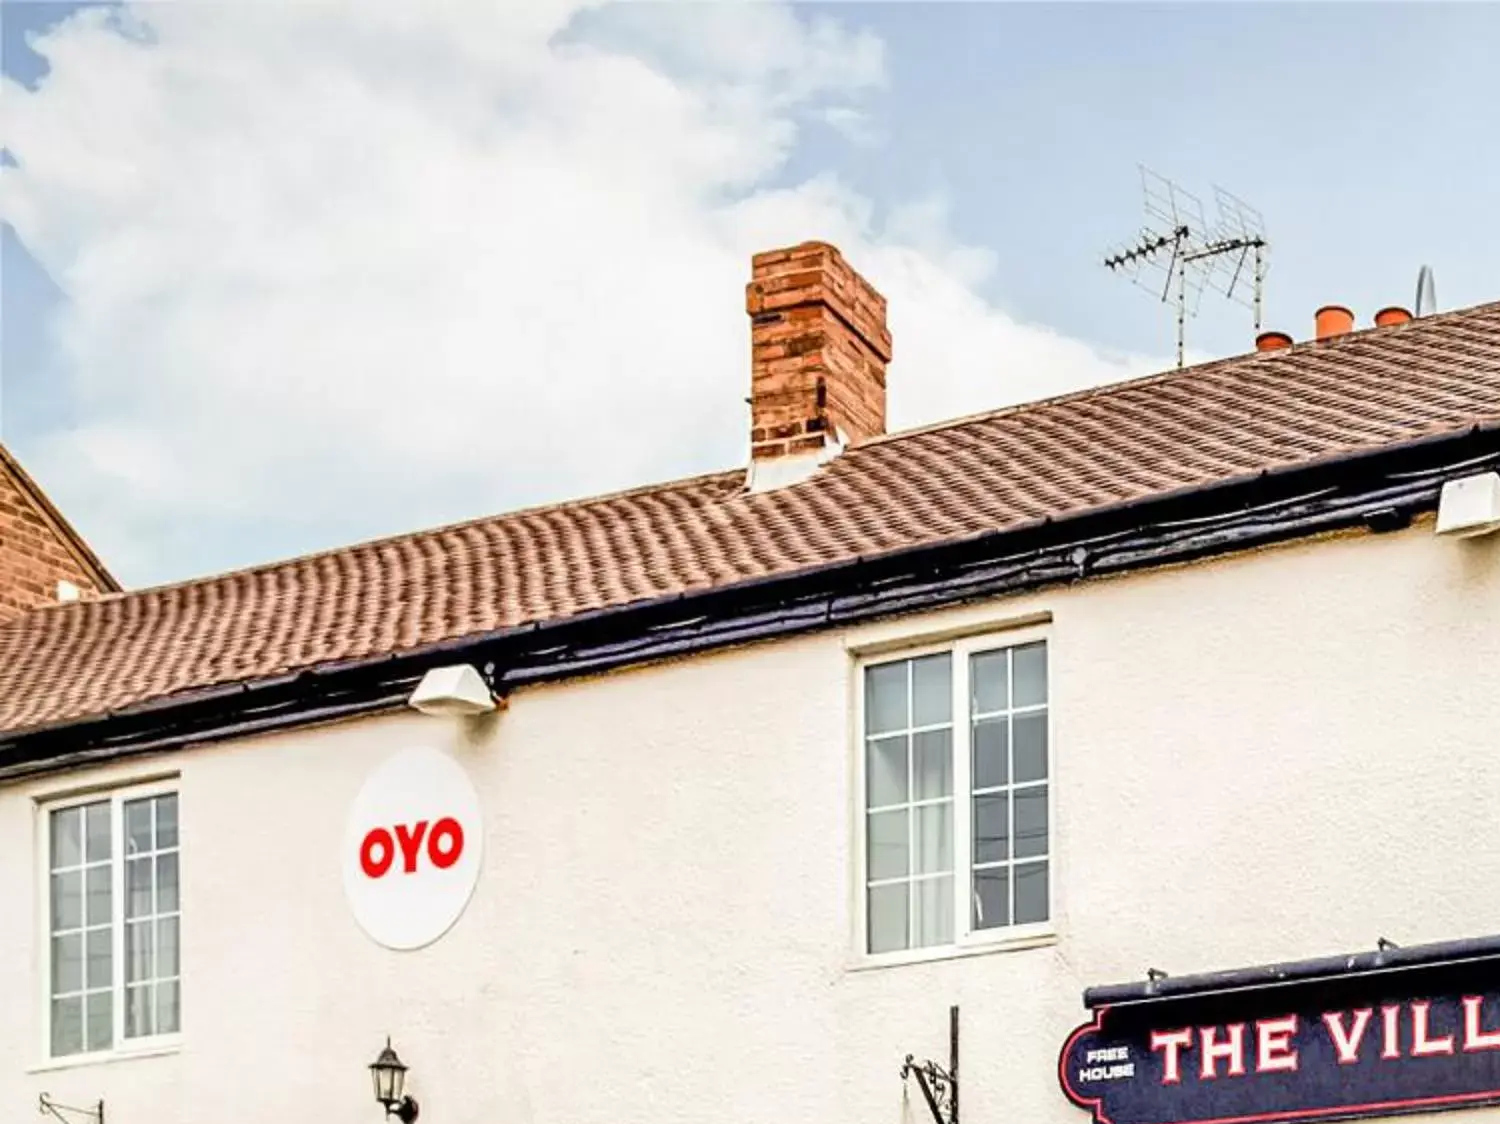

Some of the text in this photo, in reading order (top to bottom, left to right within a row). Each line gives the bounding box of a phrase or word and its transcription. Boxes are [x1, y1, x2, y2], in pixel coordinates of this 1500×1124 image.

[360, 816, 465, 878] OYO
[1087, 1046, 1129, 1064] FREE
[1150, 1013, 1300, 1086] THE
[1079, 1063, 1135, 1082] HOUSE
